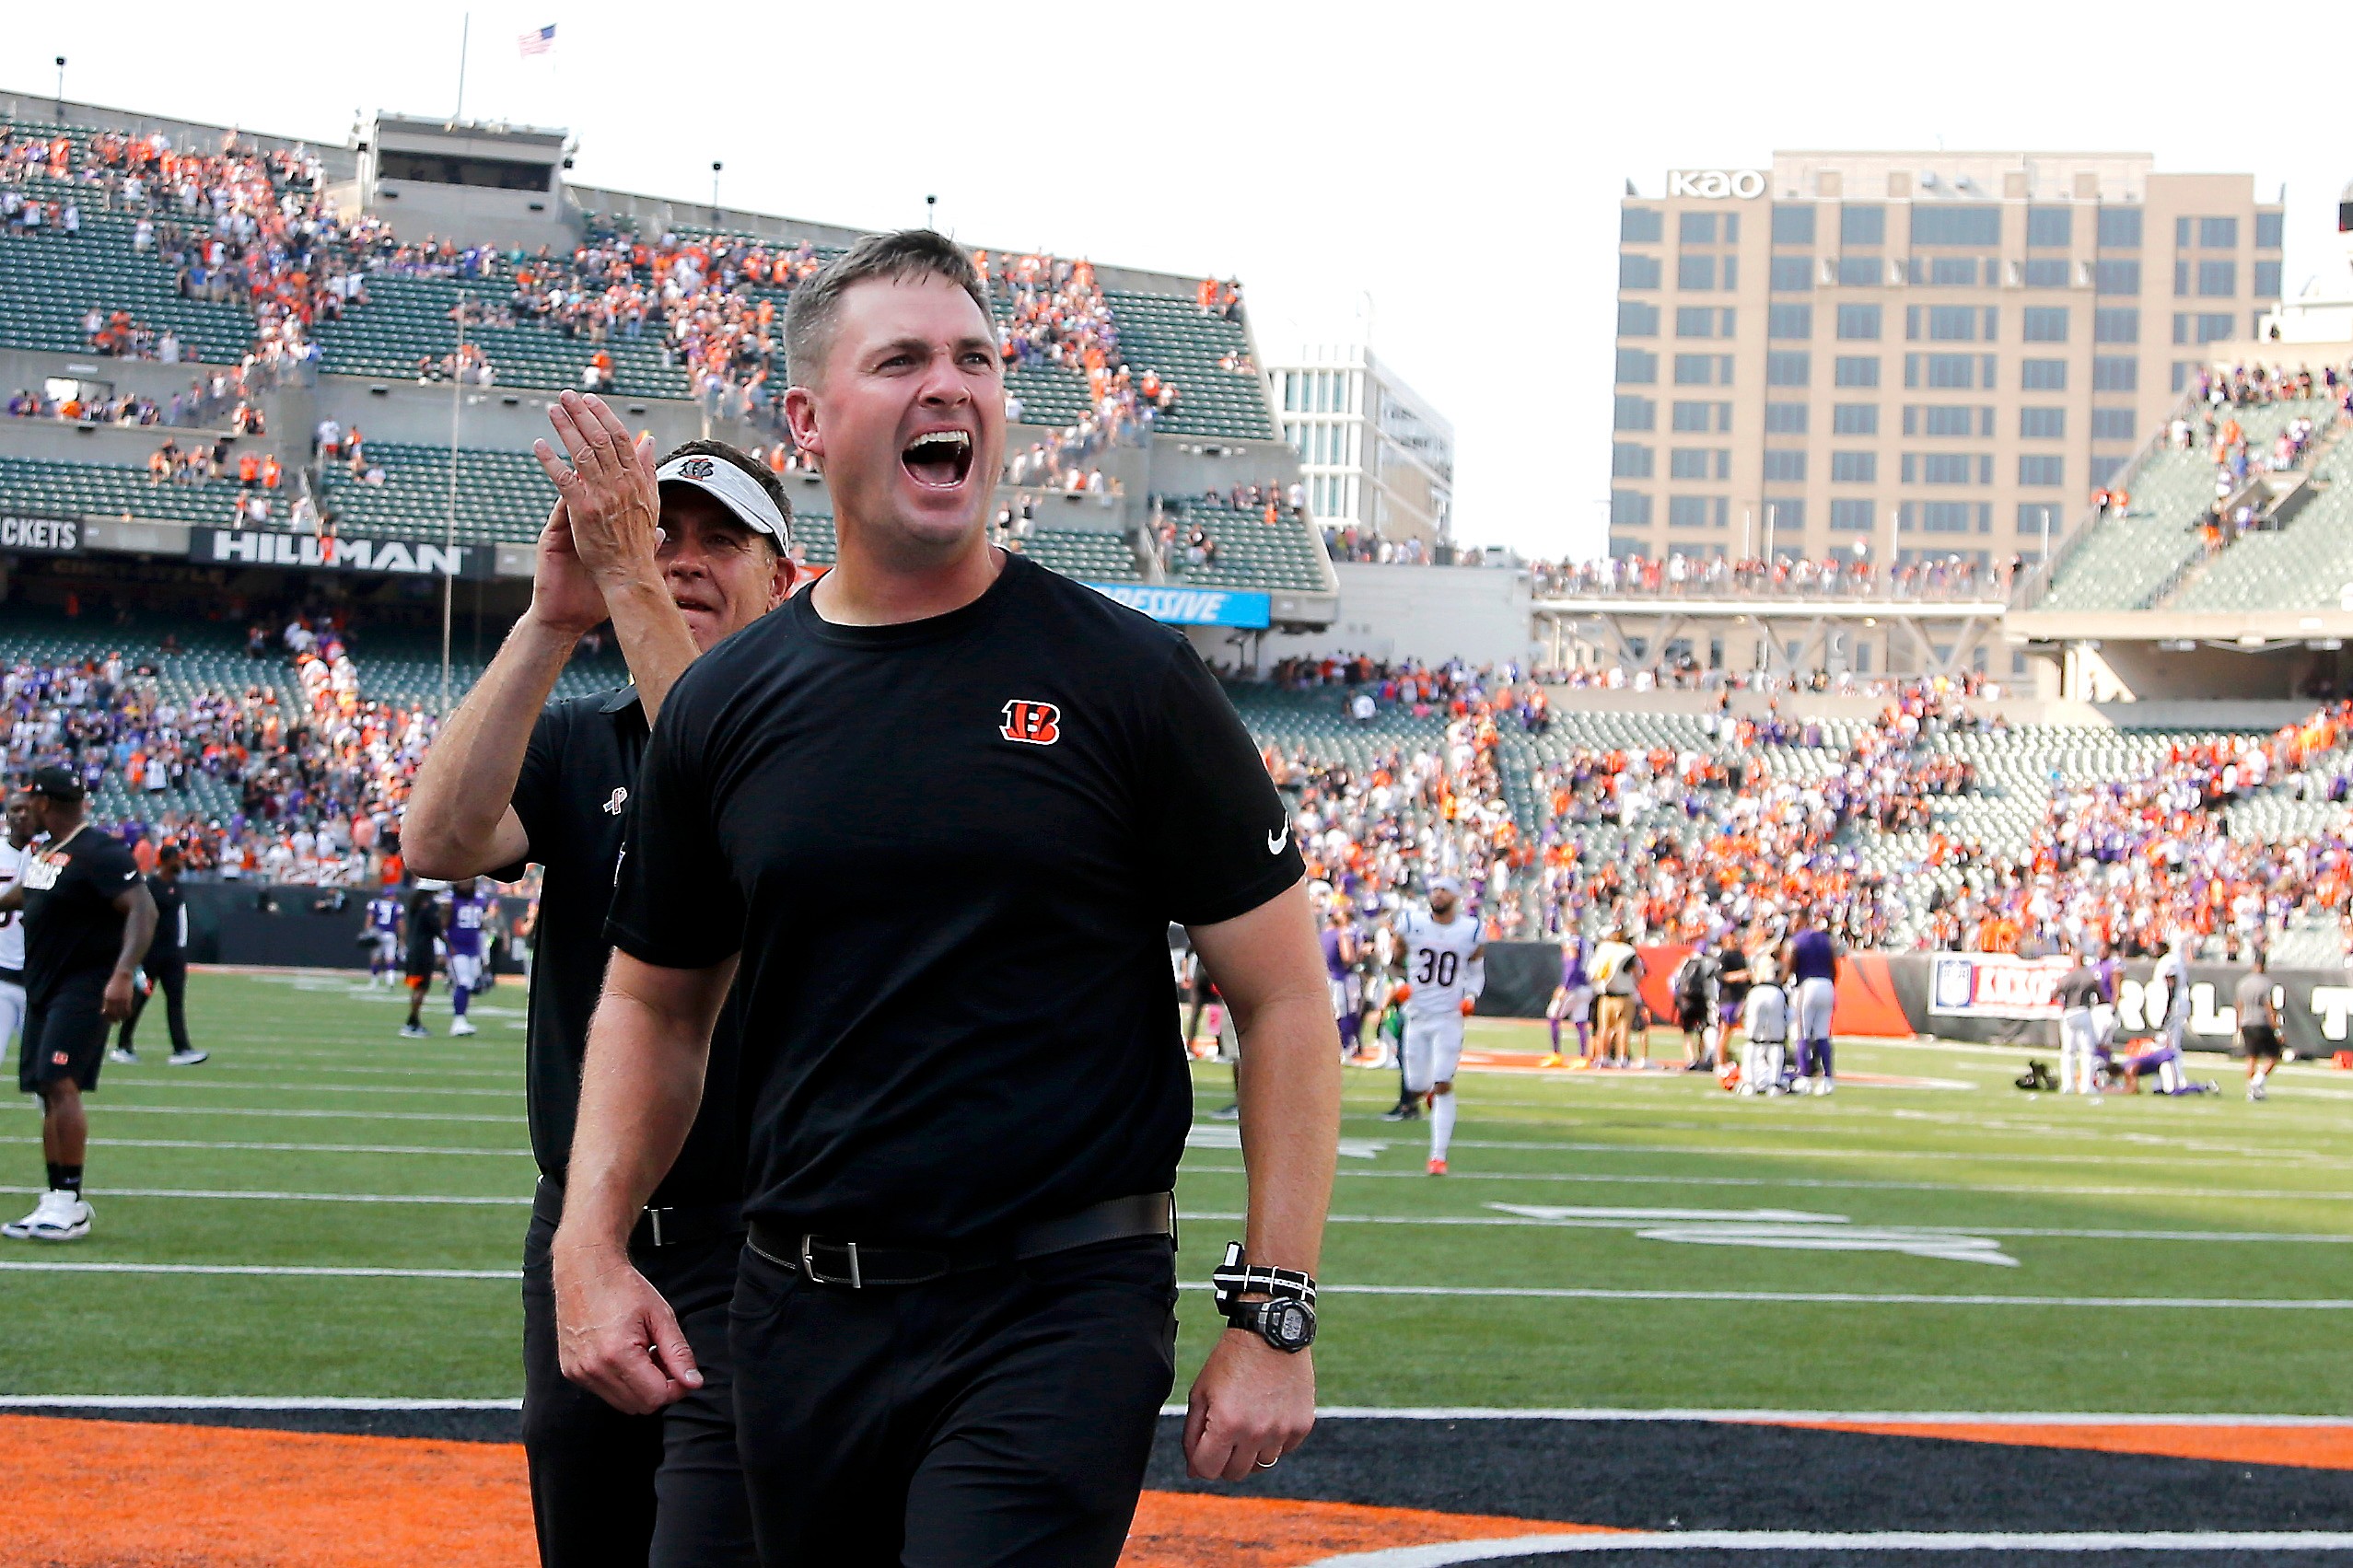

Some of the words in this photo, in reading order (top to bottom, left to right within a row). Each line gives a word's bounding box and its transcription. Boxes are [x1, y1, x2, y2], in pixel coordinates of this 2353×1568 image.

[1672, 169, 1766, 199] kao
[0, 517, 77, 550] CKETS
[213, 529, 463, 575] HILLMAN
[1417, 948, 1457, 987] 30
